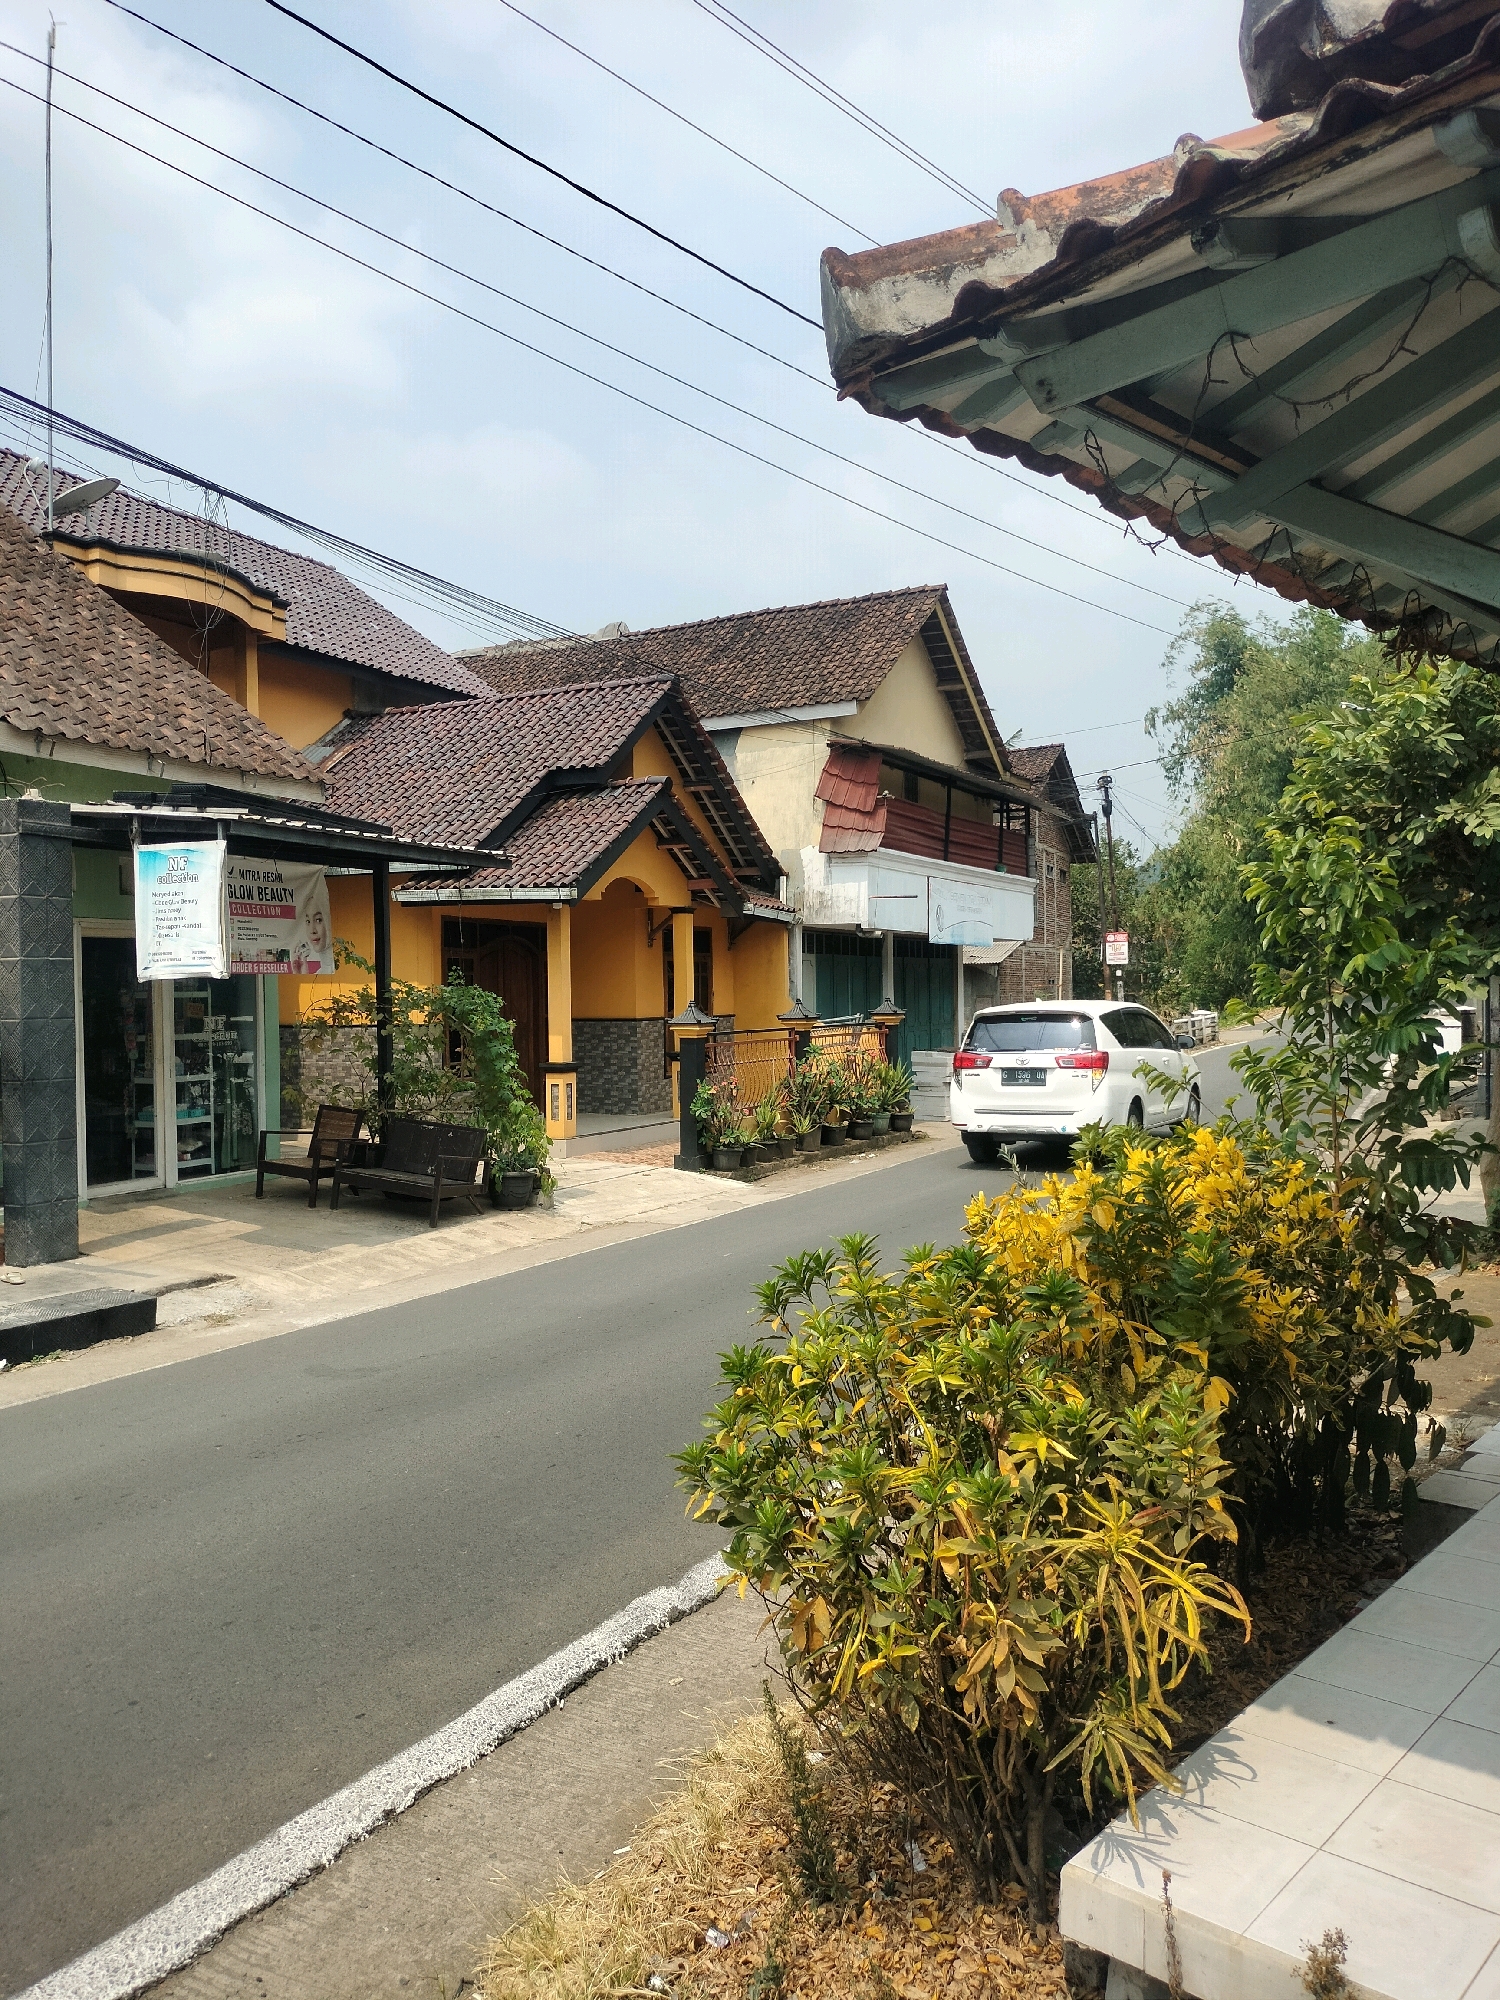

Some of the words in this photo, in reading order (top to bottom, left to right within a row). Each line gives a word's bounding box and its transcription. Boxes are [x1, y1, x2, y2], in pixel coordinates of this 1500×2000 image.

[168, 856, 189, 871] NF
[157, 872, 199, 884] collection
[239, 869, 260, 881] MITRA
[228, 884, 254, 900] GLOW
[257, 886, 294, 903] BEAUTY
[232, 904, 281, 915] COLLECTION
[232, 963, 252, 972] ORDER
[254, 963, 258, 972] &
[260, 963, 288, 973] RESELLER
